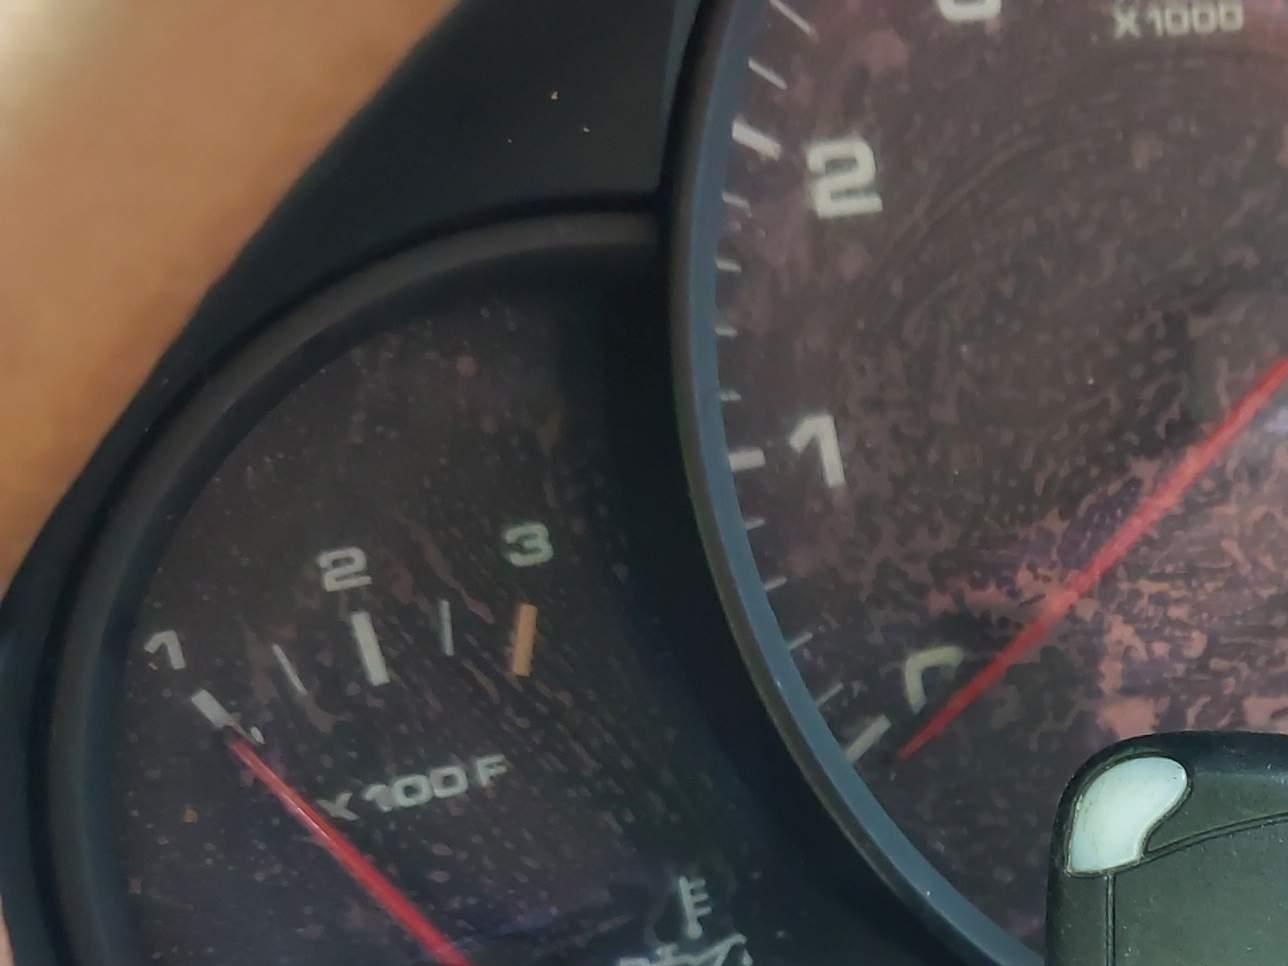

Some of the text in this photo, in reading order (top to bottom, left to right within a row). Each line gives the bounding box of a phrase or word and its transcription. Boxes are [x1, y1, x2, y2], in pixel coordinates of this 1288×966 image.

[805, 138, 883, 220] 2
[788, 413, 846, 489] 1
[504, 521, 555, 568] 3
[316, 546, 372, 592] 2
[143, 629, 187, 671] 1
